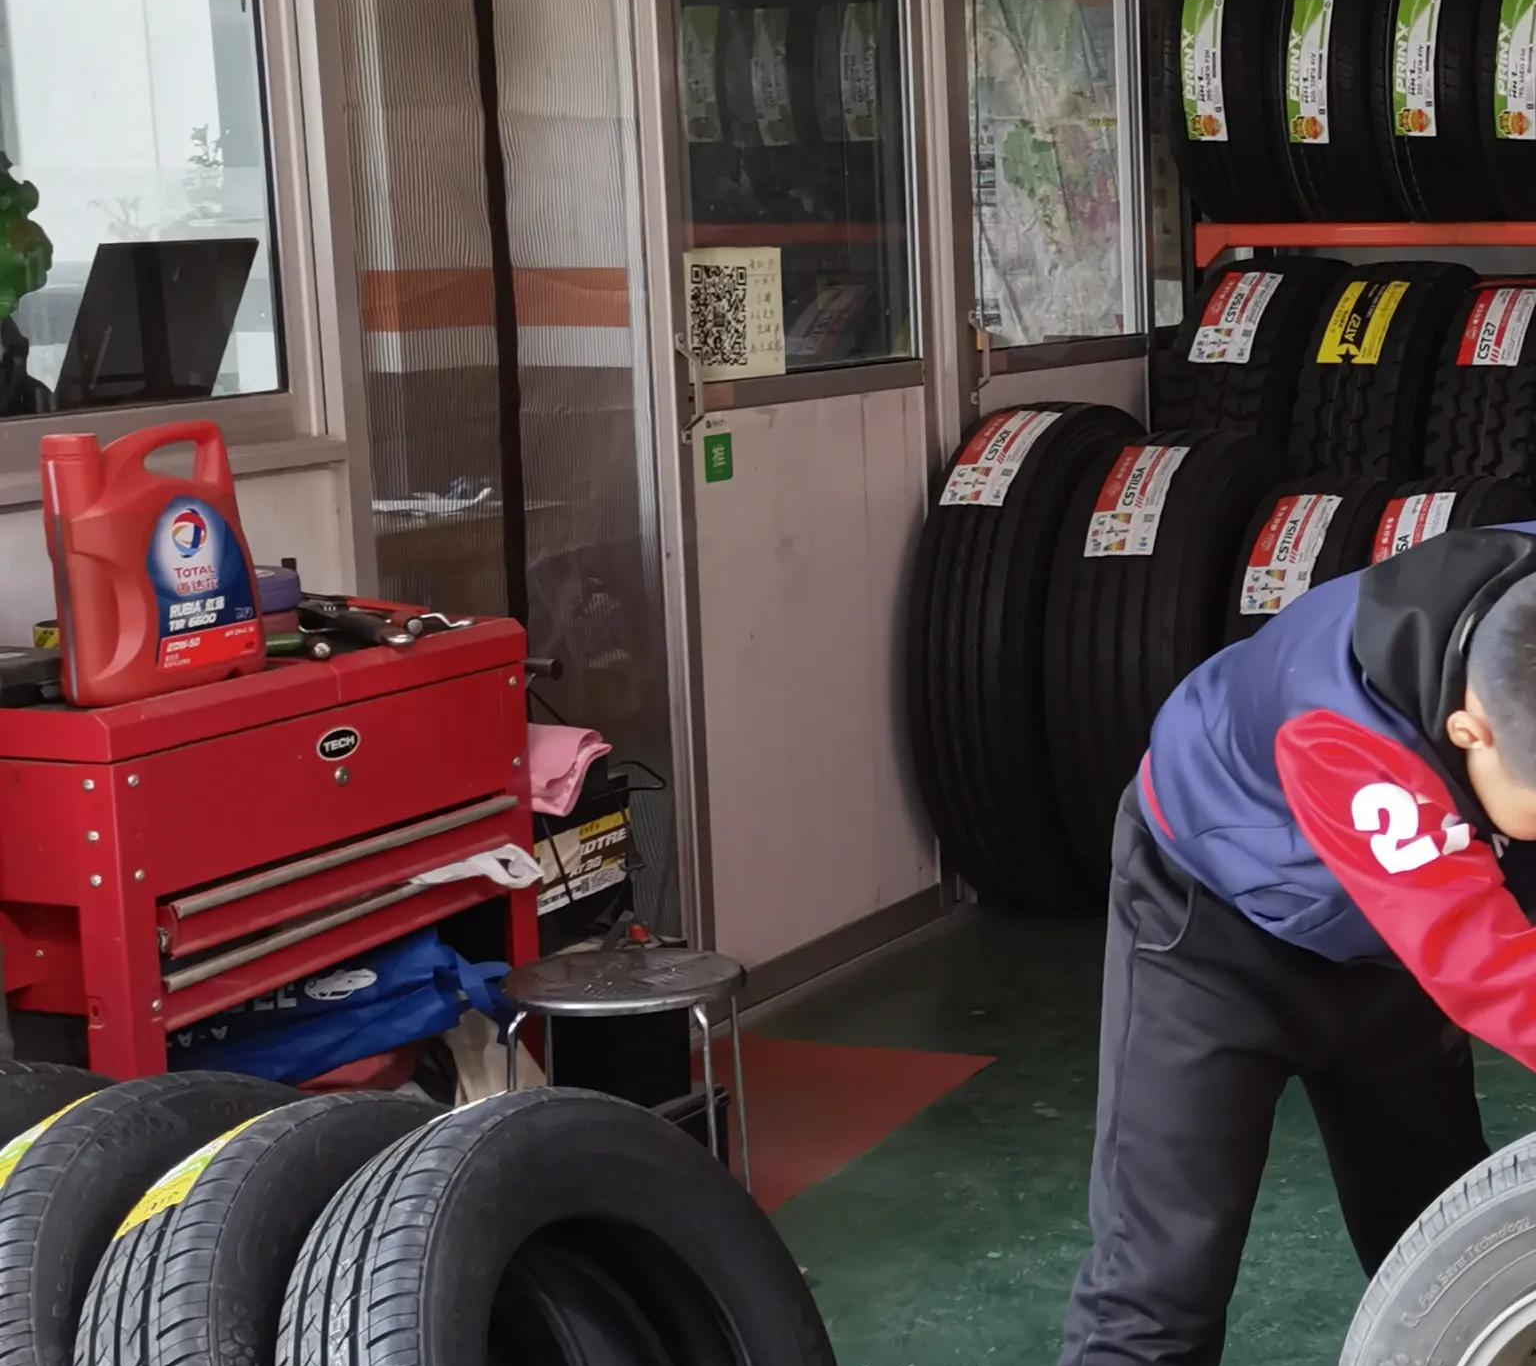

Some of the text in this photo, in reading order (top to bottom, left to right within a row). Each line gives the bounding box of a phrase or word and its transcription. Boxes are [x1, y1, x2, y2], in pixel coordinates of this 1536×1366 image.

[1182, 30, 1198, 100] PRINX
[1288, 29, 1303, 101] PRINX
[1395, 21, 1410, 94] PRINX
[1496, 21, 1512, 96] PRINX
[1343, 313, 1361, 341] AT27
[1476, 321, 1497, 360] CST27
[1122, 467, 1147, 506] CST115A
[1276, 517, 1300, 562] CST115A
[174, 566, 216, 579] TOTAL
[323, 736, 355, 753] TECH
